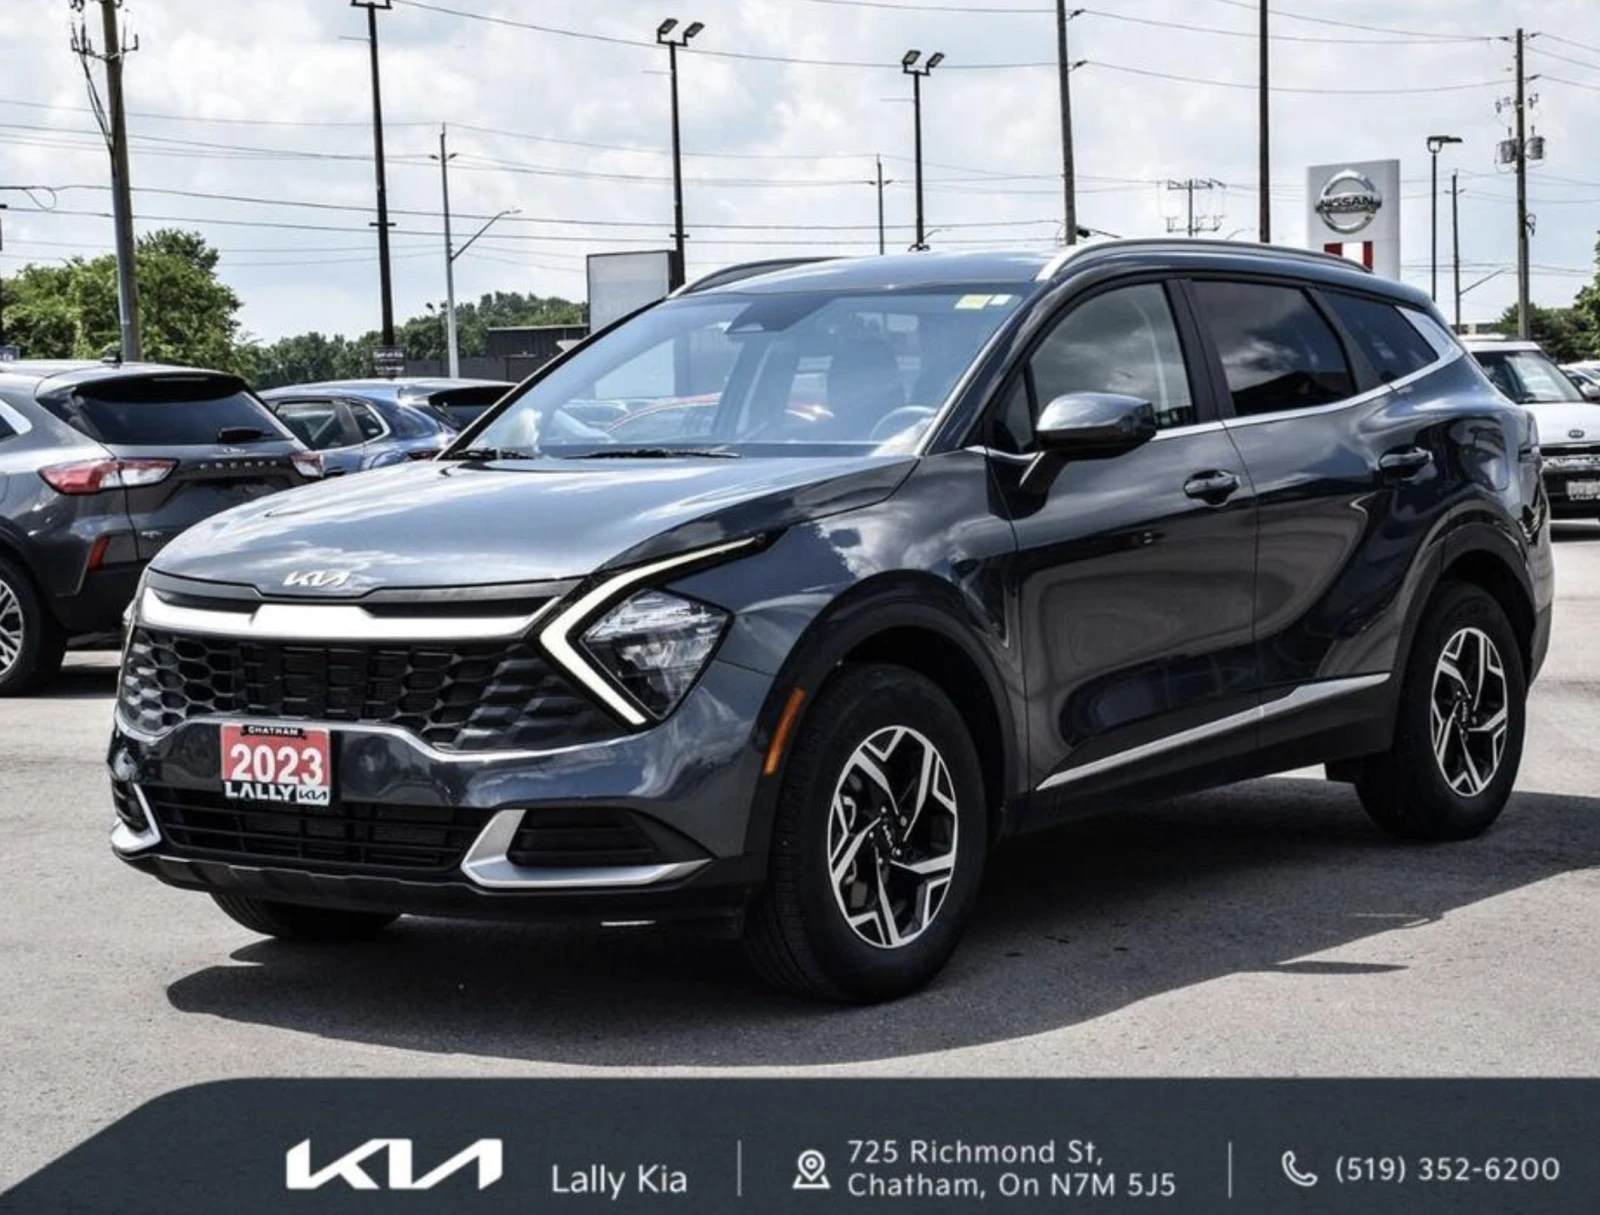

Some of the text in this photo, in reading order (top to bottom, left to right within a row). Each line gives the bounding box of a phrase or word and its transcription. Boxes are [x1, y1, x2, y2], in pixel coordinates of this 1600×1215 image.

[1320, 196, 1373, 207] NISSAN
[283, 571, 350, 587] KIA
[247, 726, 299, 736] CHATHAM
[230, 743, 323, 786] 2023
[224, 781, 295, 801] LALLY
